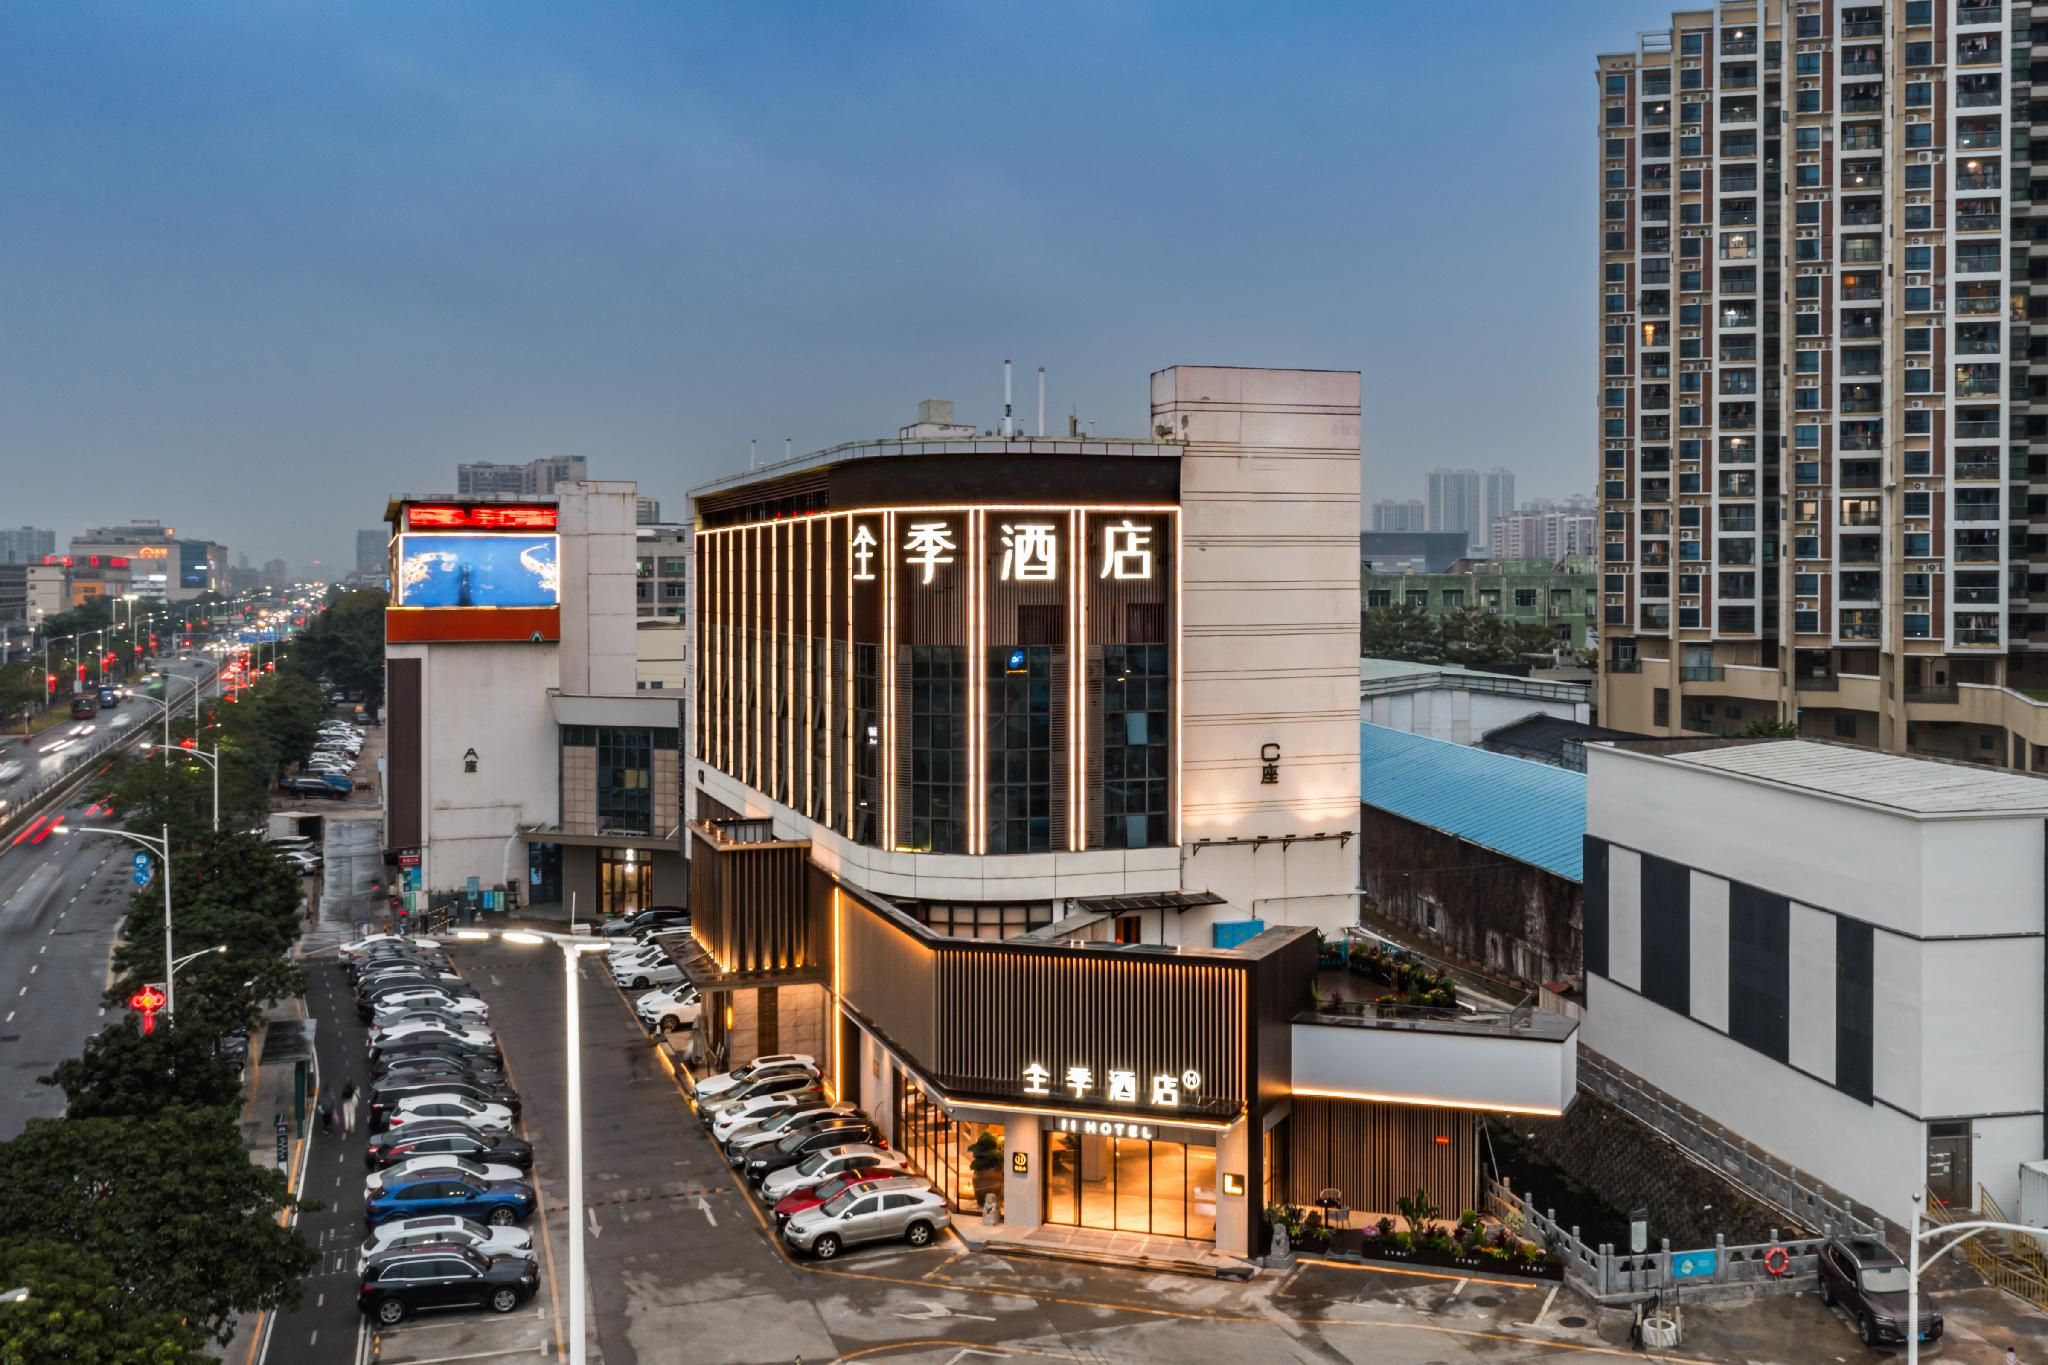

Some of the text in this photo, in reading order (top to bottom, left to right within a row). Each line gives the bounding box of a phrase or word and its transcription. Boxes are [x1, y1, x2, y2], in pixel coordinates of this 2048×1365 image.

[852, 520, 1153, 585] 全季酒店
[1085, 1120, 1152, 1139] HOTEL
